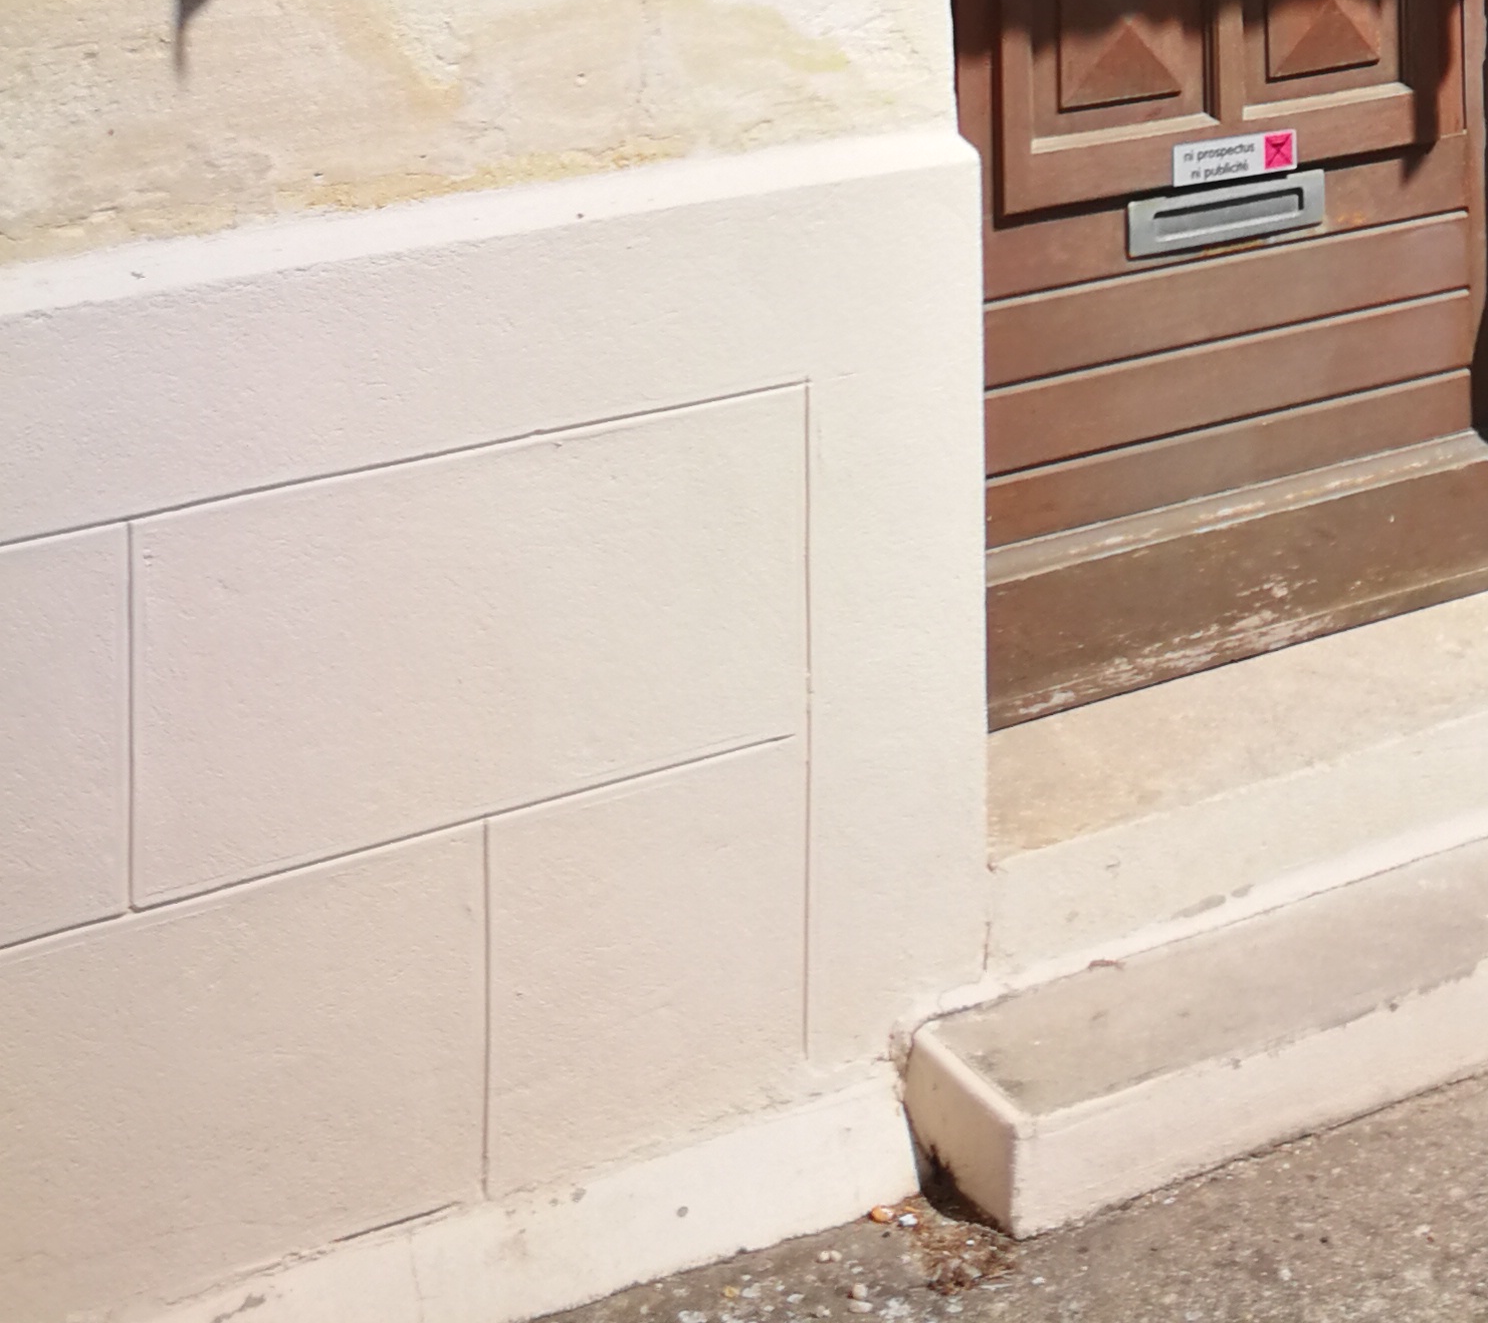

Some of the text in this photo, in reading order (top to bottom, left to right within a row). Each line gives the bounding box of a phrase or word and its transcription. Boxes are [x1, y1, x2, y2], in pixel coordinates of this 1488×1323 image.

[1183, 143, 1254, 163] ni prospectus
[1191, 160, 1249, 180] ni publicité
